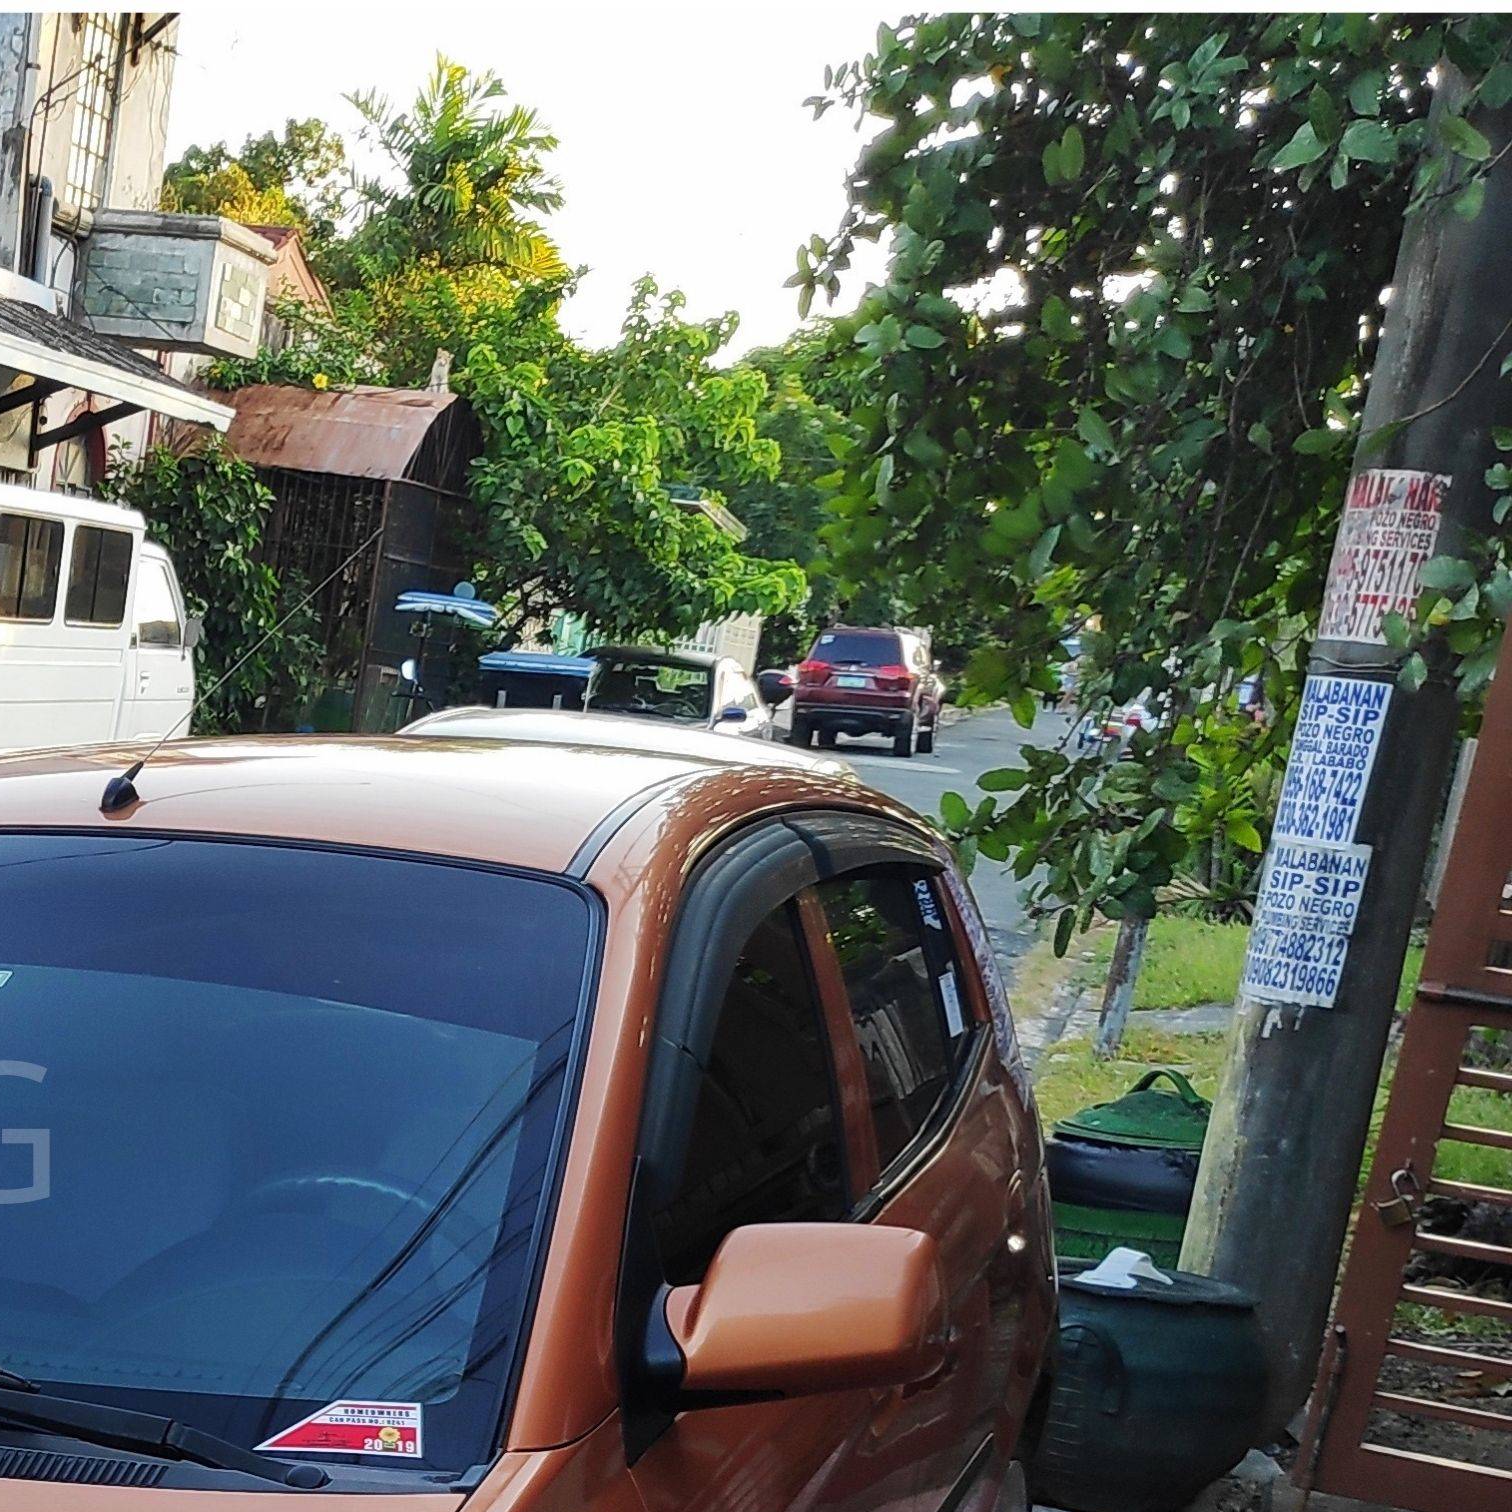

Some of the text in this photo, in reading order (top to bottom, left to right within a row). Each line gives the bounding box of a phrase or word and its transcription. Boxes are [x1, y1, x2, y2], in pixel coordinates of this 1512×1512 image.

[1348, 474, 1443, 512] MALANAN
[1369, 511, 1397, 528] POZO
[1399, 512, 1437, 531] NEGRO
[1380, 530, 1432, 550] SERVICES
[1305, 679, 1387, 709] MALABANAN
[1300, 703, 1380, 726] SIP-SIP
[1322, 724, 1375, 744] NEGRO
[1326, 741, 1370, 758] BARADO
[1312, 754, 1367, 771] LABABO
[1275, 847, 1368, 878] MALABANAN
[1270, 870, 1361, 898] SIP-SIP
[1265, 891, 1355, 918] POZO NEGRO
